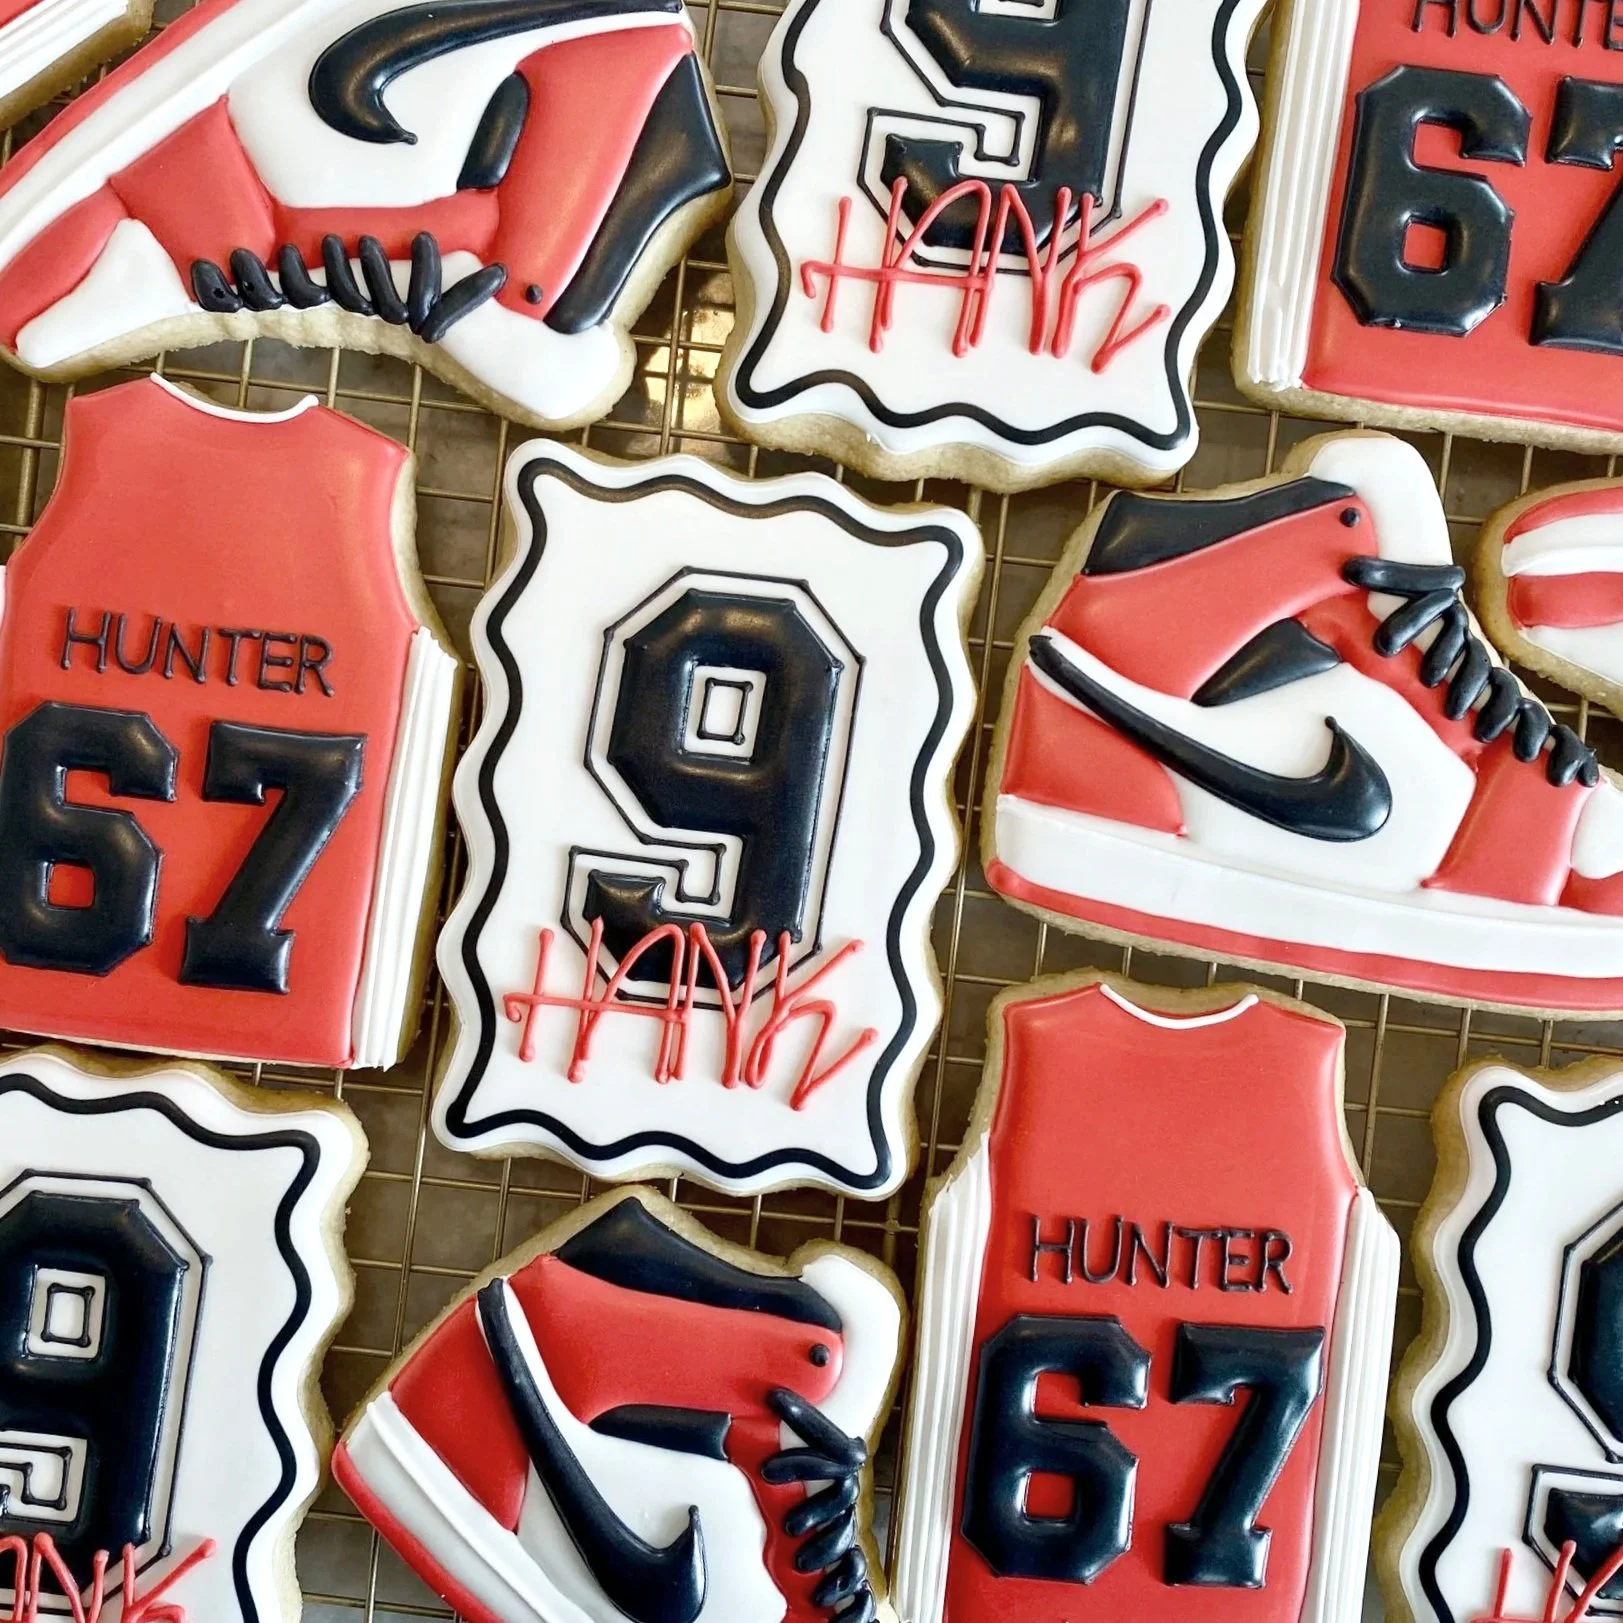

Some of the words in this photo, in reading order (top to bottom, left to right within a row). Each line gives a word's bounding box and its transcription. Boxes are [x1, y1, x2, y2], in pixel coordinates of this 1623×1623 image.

[801, 176, 1171, 375] HANK
[60, 606, 337, 698] HUNTER
[0, 700, 369, 995] 67
[559, 566, 867, 1011] 9
[503, 916, 879, 1112] HANK
[1028, 1213, 1294, 1295] HUNTER
[961, 1313, 1327, 1590] 67
